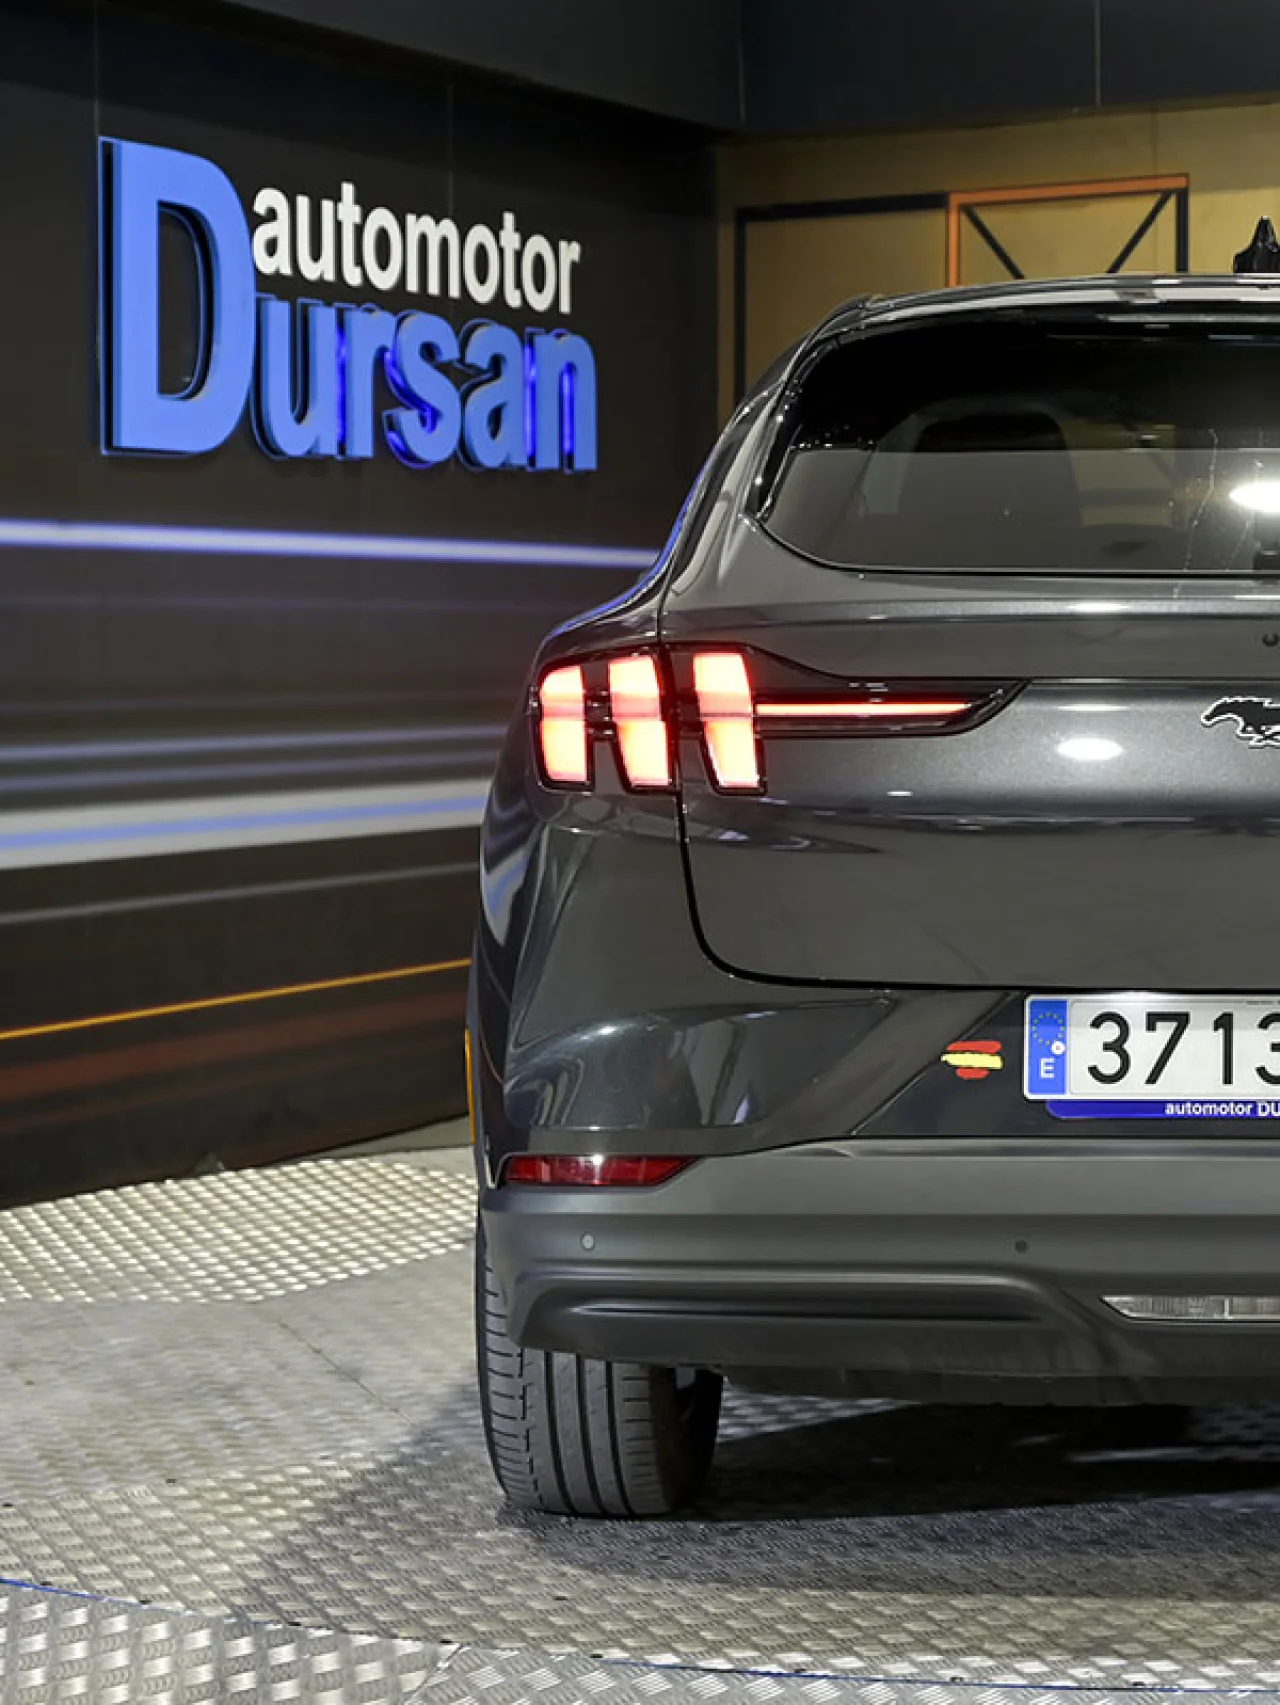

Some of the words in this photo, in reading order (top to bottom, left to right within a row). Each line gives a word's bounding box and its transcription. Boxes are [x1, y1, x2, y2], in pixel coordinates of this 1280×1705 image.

[252, 182, 582, 314] automotor
[99, 136, 598, 474] Dursan
[1040, 1058, 1055, 1079] E
[1164, 1101, 1253, 1116] automotor
